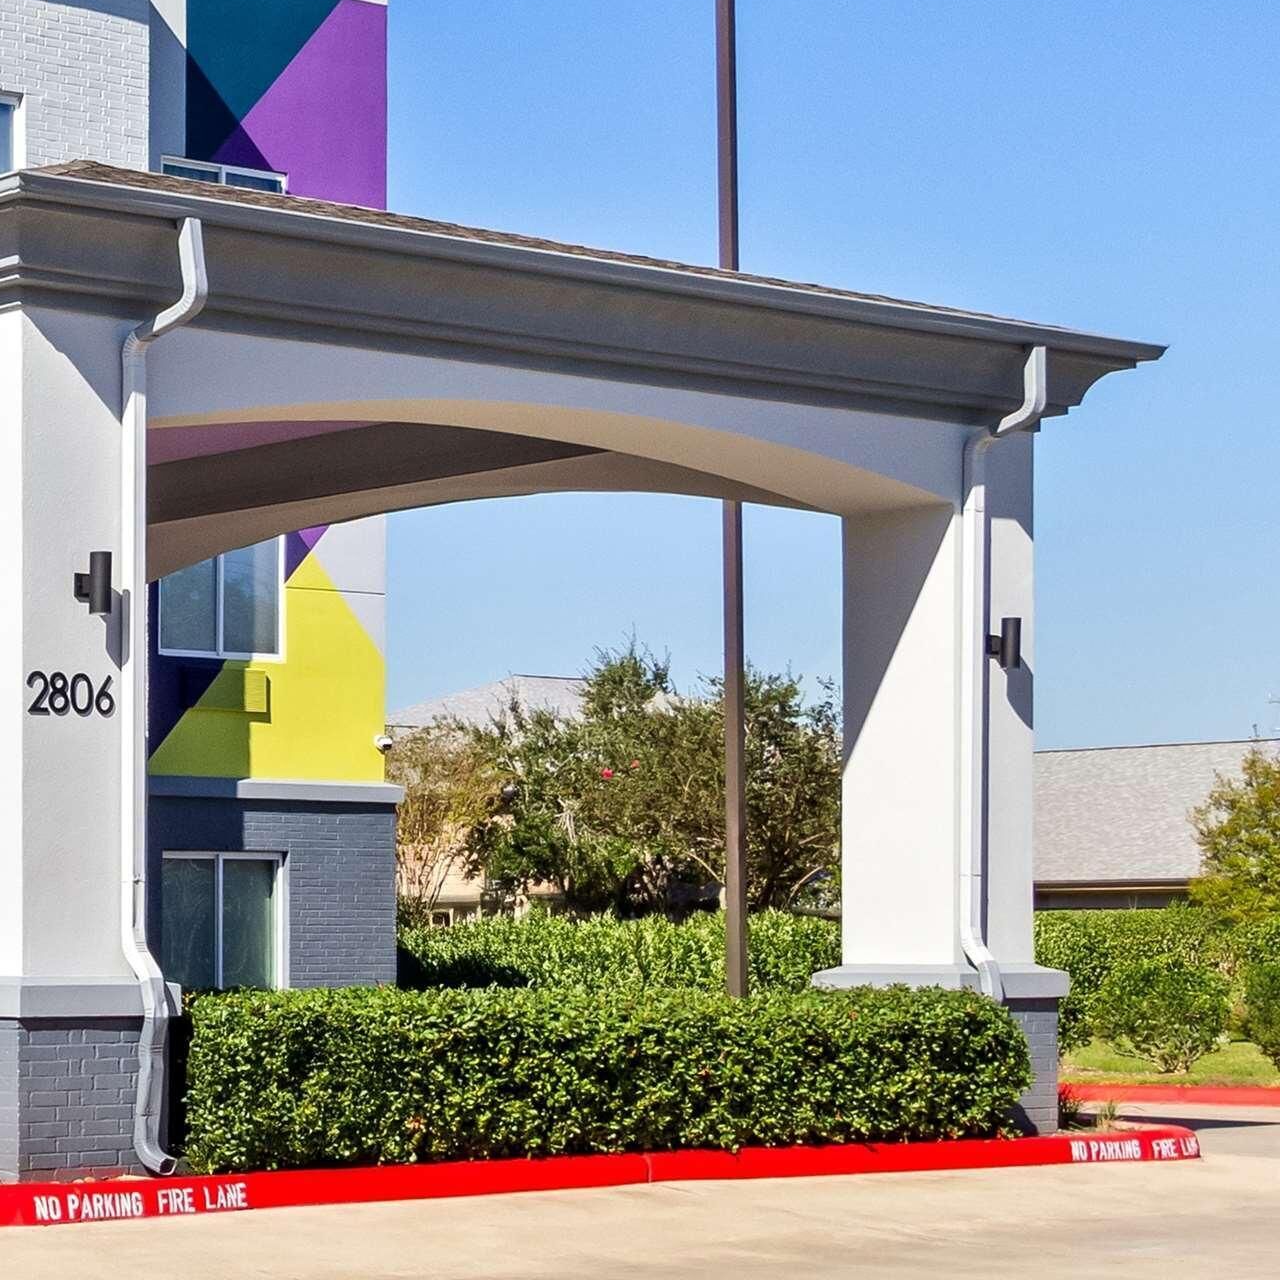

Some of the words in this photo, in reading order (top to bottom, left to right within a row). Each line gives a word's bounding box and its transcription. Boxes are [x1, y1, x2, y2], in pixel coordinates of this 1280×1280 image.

[26, 670, 117, 718] 2806
[1070, 1141, 1088, 1161] NO
[1090, 1139, 1141, 1161] PARKING
[1151, 1138, 1179, 1160] FIRE
[34, 1195, 61, 1221] NO
[67, 1191, 144, 1220] PARKING
[157, 1187, 196, 1214] FIRE
[203, 1182, 248, 1210] LANE
